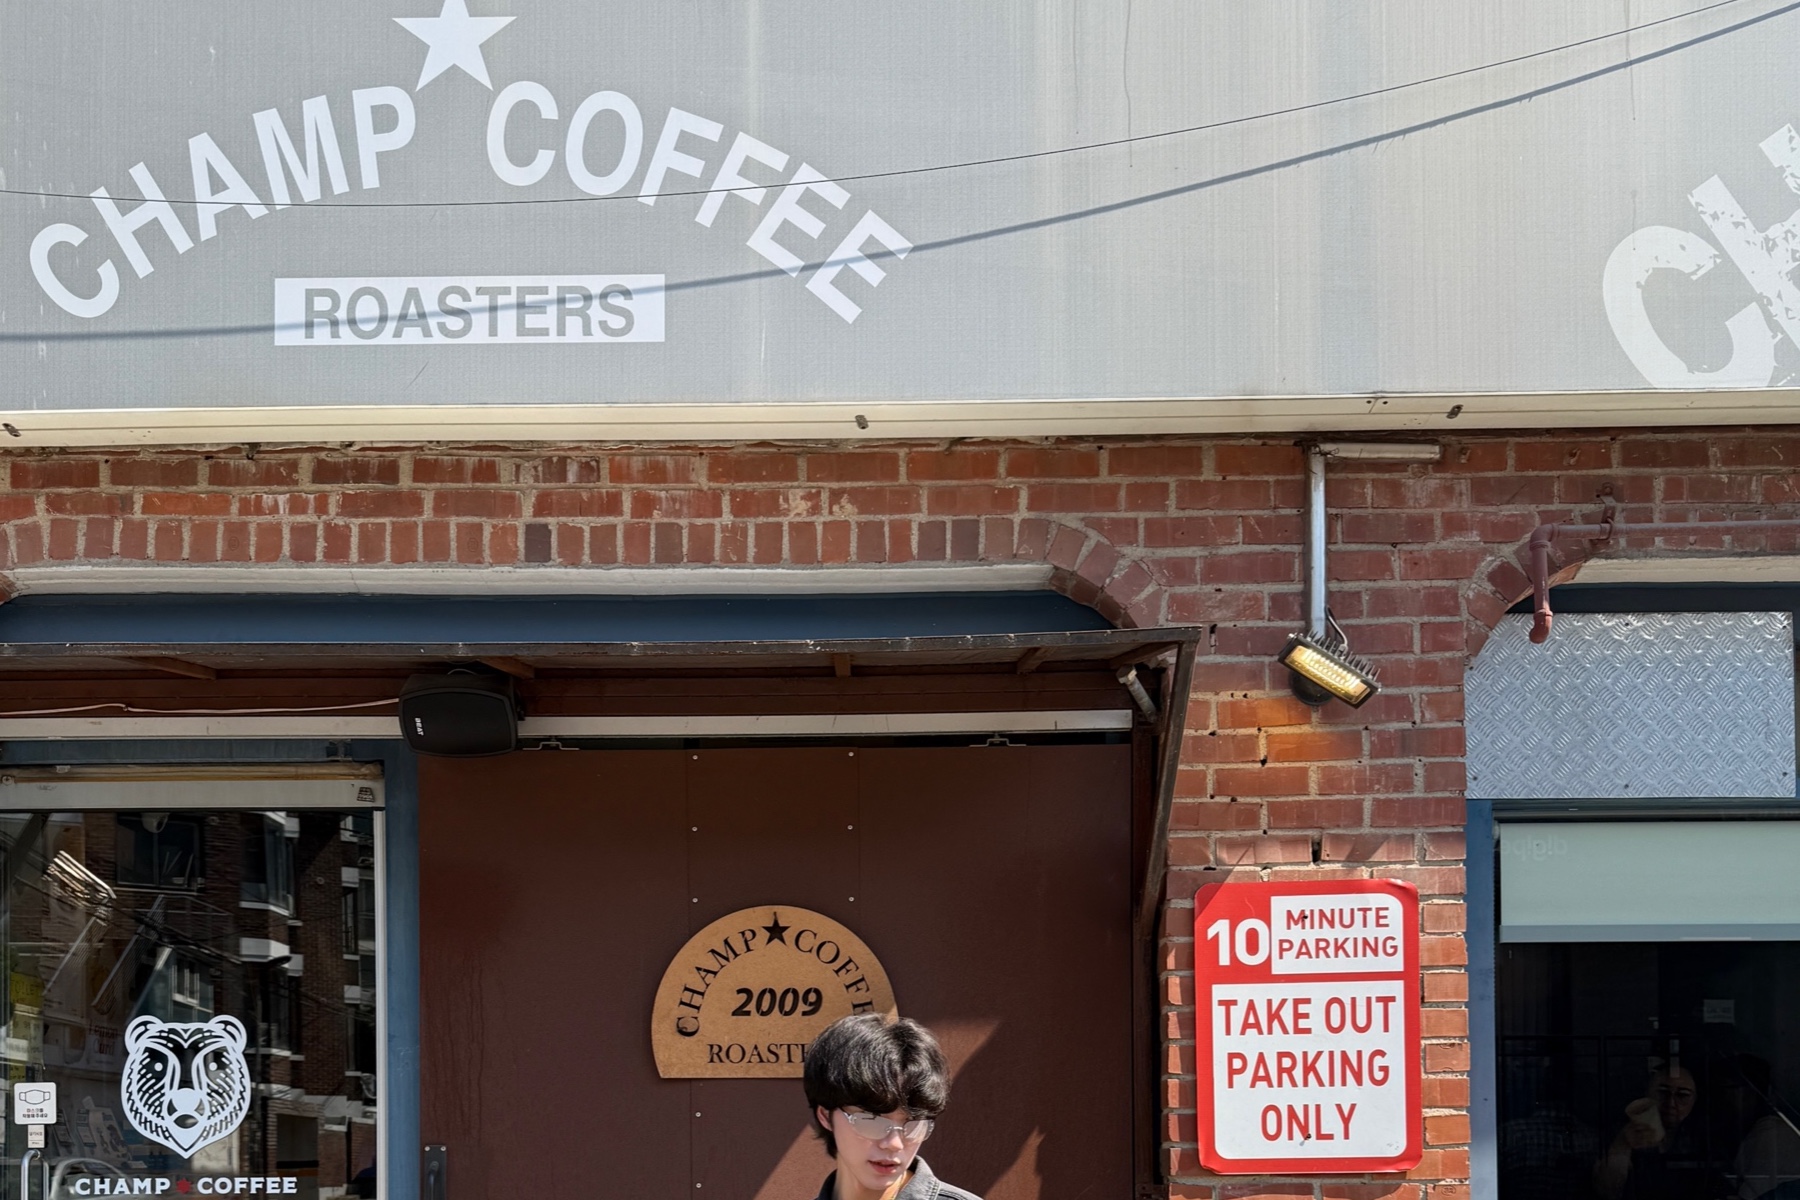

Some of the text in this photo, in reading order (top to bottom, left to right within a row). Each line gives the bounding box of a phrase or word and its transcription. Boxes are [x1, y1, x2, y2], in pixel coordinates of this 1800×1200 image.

[29, 80, 914, 325] CHAMP COFFEE
[303, 286, 636, 340] ROASTERS
[414, 717, 424, 736] BEAT
[1285, 906, 1390, 931] MINUTE
[1206, 918, 1271, 967] 10
[1277, 935, 1399, 960] PARKING
[675, 928, 875, 1038] CHAMP COFFE
[731, 987, 823, 1017] 2009
[1217, 995, 1396, 1037] TAKE OUT
[1226, 1048, 1390, 1089] PARKING
[1260, 1102, 1358, 1142] ONLY
[74, 1176, 298, 1195] CHAMP COFFEE
